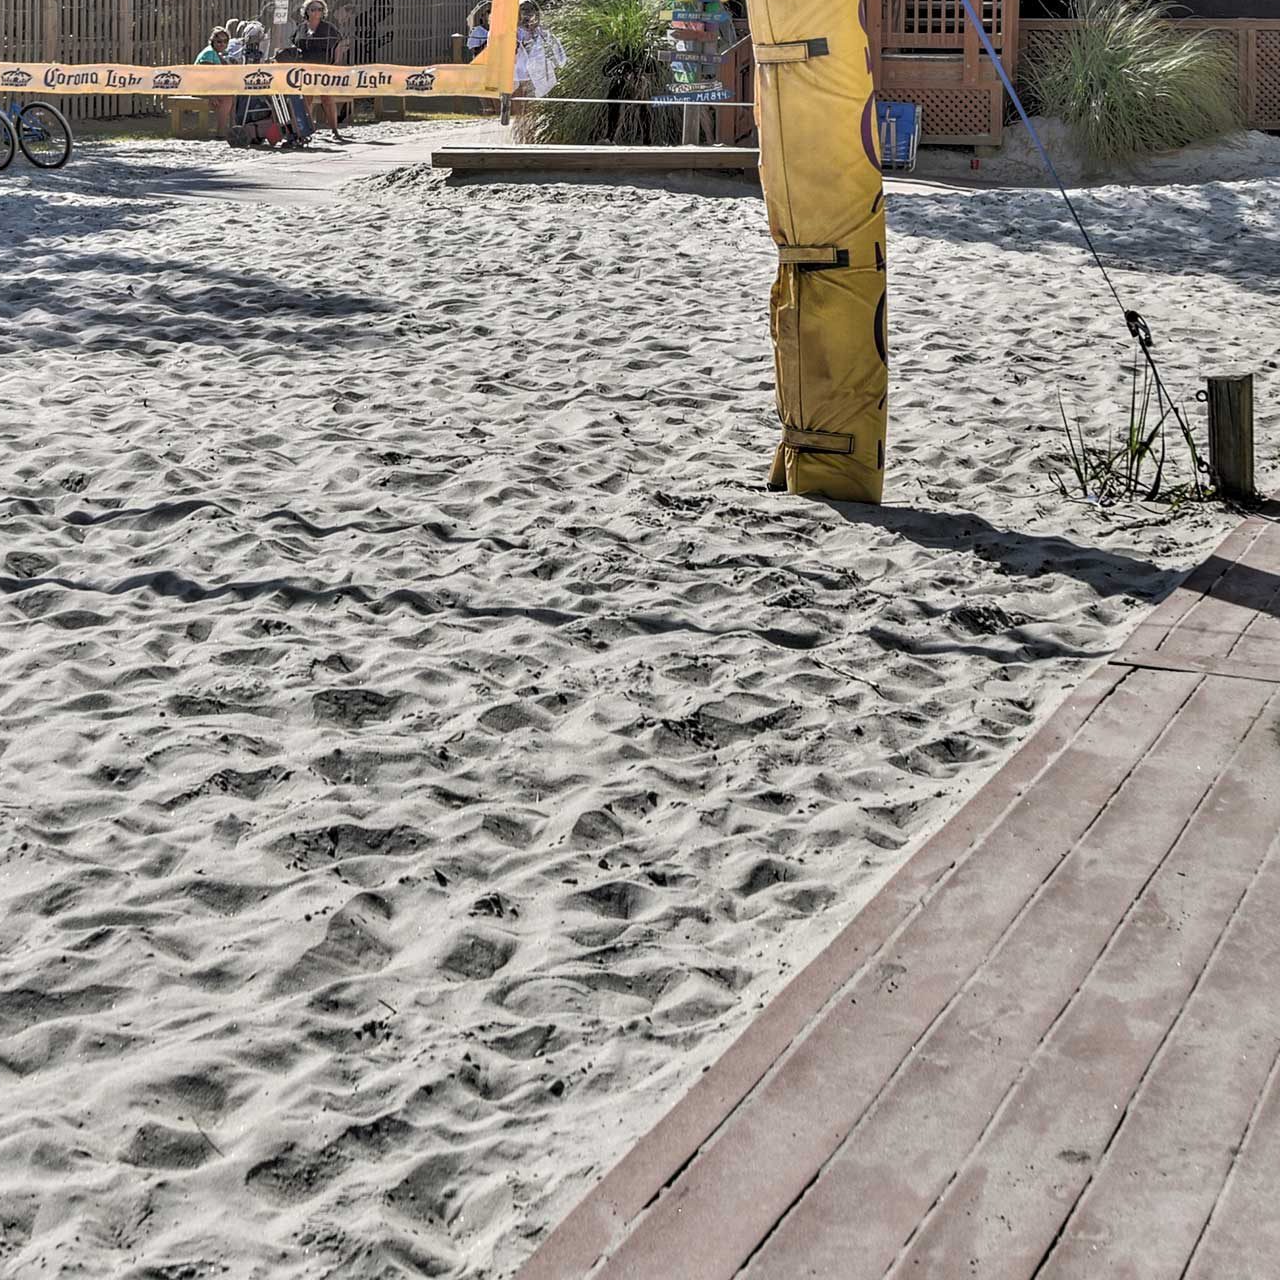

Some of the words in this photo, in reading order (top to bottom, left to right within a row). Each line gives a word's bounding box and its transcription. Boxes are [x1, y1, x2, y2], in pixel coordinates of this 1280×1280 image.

[43, 67, 100, 91] Corona
[104, 69, 143, 89] Light
[286, 67, 350, 92] Corona
[355, 69, 393, 90] Light
